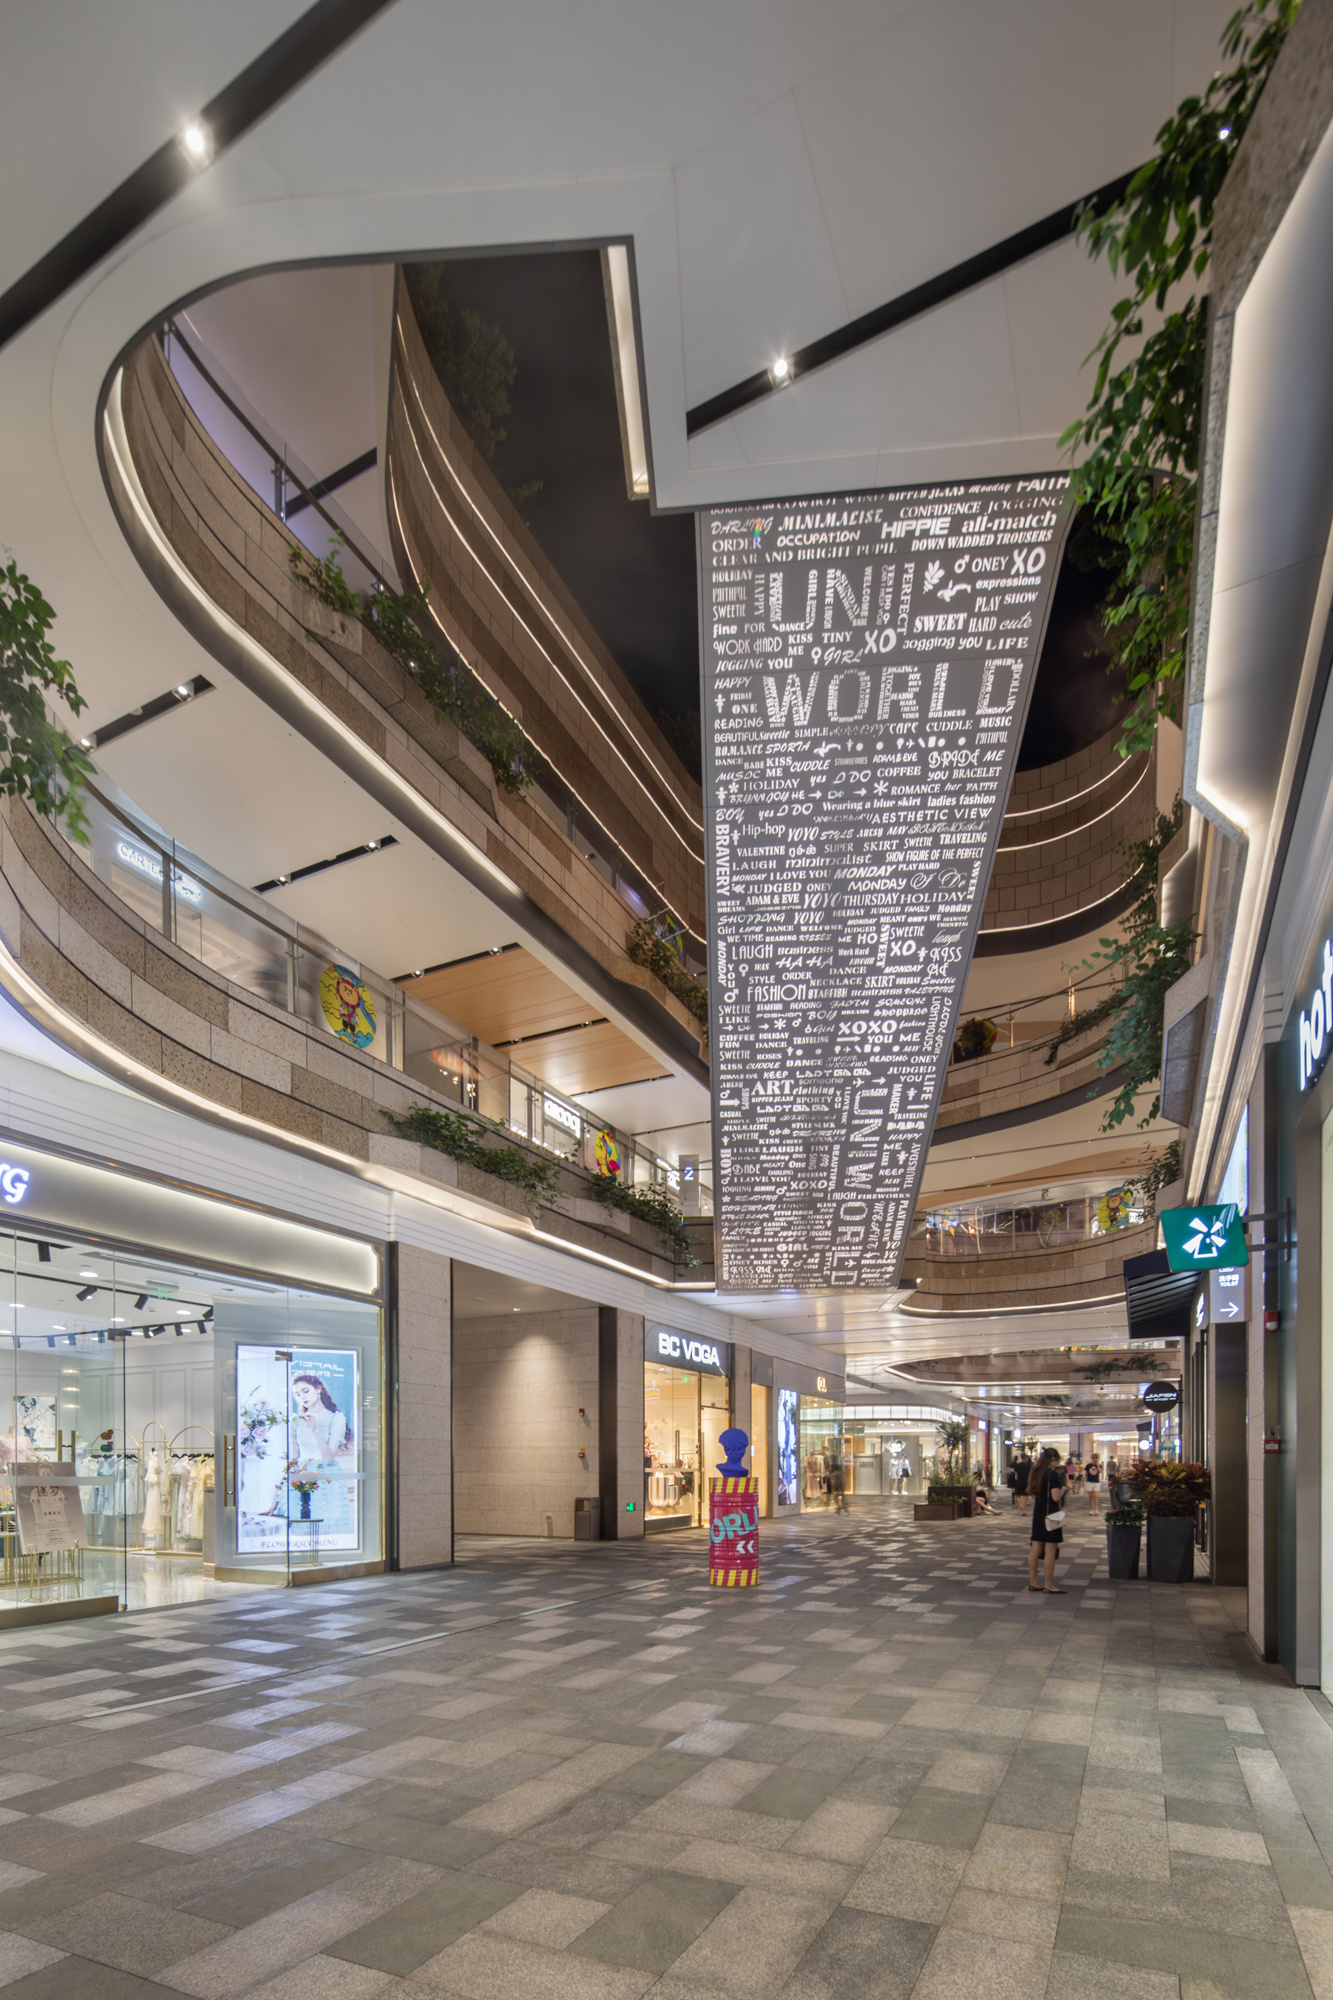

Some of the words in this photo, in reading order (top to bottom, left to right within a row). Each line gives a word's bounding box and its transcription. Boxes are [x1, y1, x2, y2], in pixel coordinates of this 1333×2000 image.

[968, 483, 1012, 495] Monday
[900, 501, 982, 519] CONFIDENCE
[711, 516, 775, 536] DARLING
[777, 509, 884, 532] MINIMALIST
[881, 516, 952, 539] HIPPIE
[961, 510, 1058, 534] all-match
[712, 537, 762, 553] ORDER
[777, 530, 861, 548] OCCUPATION
[911, 537, 946, 552] DOWN
[947, 533, 996, 550] WADDED
[996, 529, 1054, 546] TROUSERS
[971, 556, 1009, 573] ONEY
[1010, 545, 1047, 576] XO
[712, 569, 753, 583] HOLIDAY
[975, 575, 1042, 591] expressions
[861, 565, 873, 617] WELCOME
[897, 562, 915, 636] PERFECT
[974, 595, 1002, 613] PLAY
[1003, 591, 1040, 605] SHOW
[713, 604, 747, 621] SWEETIE
[780, 621, 806, 632] DANCE
[913, 612, 968, 634] SWEET
[968, 616, 997, 633] HARD
[999, 610, 1033, 631] cute
[713, 623, 739, 638] fine
[744, 622, 765, 633] FOR
[822, 631, 853, 644] TINY
[713, 639, 751, 656] WORK
[753, 636, 782, 653] HARD
[787, 633, 814, 645] KISS
[864, 627, 898, 656] XO
[985, 636, 1029, 651] LIFE
[787, 645, 806, 656] ME
[823, 645, 864, 667] GIRL
[715, 658, 764, 674] JOGGING
[714, 676, 753, 690] HAPPY
[731, 703, 758, 714] ONE
[714, 717, 764, 730] READING
[925, 720, 974, 733] CUDDLE
[979, 716, 1013, 729] MUSIC
[714, 731, 761, 744] BEAUTIFUL
[794, 727, 829, 739] SIMPLE
[715, 743, 764, 757] ROMANCE
[982, 750, 1007, 762] ME
[766, 756, 793, 768] KISS
[789, 759, 832, 774] CUDDLE
[766, 767, 785, 778] ME
[809, 775, 827, 787] yes
[847, 770, 873, 783] DO
[876, 766, 921, 778] COFFEE
[952, 766, 1003, 779] BRACELET
[743, 778, 801, 792] HOLIDAY
[890, 784, 941, 797] ROMANCE
[944, 781, 963, 792] her
[822, 801, 863, 812] Wearing
[864, 801, 872, 809] a
[873, 797, 898, 809] blue
[898, 795, 921, 807] skirt
[926, 795, 957, 808] ladies
[959, 791, 997, 806] fashion
[714, 807, 747, 824] BOY
[870, 809, 949, 825] AESTHETIC
[954, 806, 993, 820] VIEW
[742, 823, 786, 840] Hip-hop
[786, 826, 820, 843] YOYO
[940, 831, 987, 846] TRAVELING
[863, 840, 901, 853] SKIRT
[903, 836, 934, 850] SWEETIE
[737, 846, 786, 858] VALENTINE
[886, 850, 905, 863] SHOW
[905, 849, 930, 861] FIGURE
[930, 848, 941, 859] OF
[942, 847, 956, 859] THE
[956, 847, 985, 859] PERFECT
[119, 844, 164, 878] CARTE
[715, 823, 731, 898] BRAVERY
[732, 860, 777, 871] LAUGH
[898, 863, 917, 871] PLAY
[918, 861, 940, 870] HARD
[776, 869, 808, 880] LOVE
[808, 869, 833, 879] YOU
[833, 865, 897, 880] MONDAY
[747, 882, 803, 896] JUDGED
[806, 883, 833, 894] ONEY
[847, 877, 907, 893] MONDAY
[802, 890, 842, 910] YOYO
[842, 892, 899, 907] THURSDAY
[900, 891, 967, 904] HOLIDAY
[937, 903, 973, 914] Monday
[717, 924, 736, 935] Girl
[889, 924, 926, 941] SWEETIE
[856, 933, 879, 945] HO
[876, 923, 891, 968] SWEET
[731, 943, 774, 961] LAUGH
[889, 939, 918, 958] XO
[716, 939, 729, 988] MONDAY
[782, 970, 813, 981] ORDER
[864, 974, 896, 989] SKIRT
[746, 982, 807, 1003] FASHION
[875, 996, 927, 1008] SOMEONE
[838, 1018, 898, 1036] XOXO
[922, 995, 942, 1053] LIGHTHOUSE
[865, 1034, 894, 1044] YOU
[899, 1032, 923, 1043] ME
[785, 1059, 824, 1068] DANCE
[910, 1054, 940, 1064] ONEY
[763, 1070, 789, 1080] KEEP
[886, 1064, 937, 1076] JUDGED
[750, 1079, 795, 1097] ART
[792, 1085, 836, 1097] clothing
[920, 1073, 938, 1102] LIFE
[888, 1083, 904, 1115] MAKER
[893, 1111, 928, 1121] TRAVELING
[888, 1132, 925, 1141] HAPPY
[761, 1145, 804, 1155] LAUGH
[883, 1142, 903, 1151] ME
[684, 1165, 695, 1181] 2
[827, 1143, 841, 1192] BEAUTIFUL
[903, 1142, 922, 1189] THURSDAY
[0, 1163, 30, 1203] G
[789, 1178, 829, 1191] XOXO
[857, 1192, 911, 1201] FIREWORKS
[776, 1242, 810, 1254] GIRL
[658, 1332, 681, 1358] BC
[682, 1338, 720, 1368] VOGA
